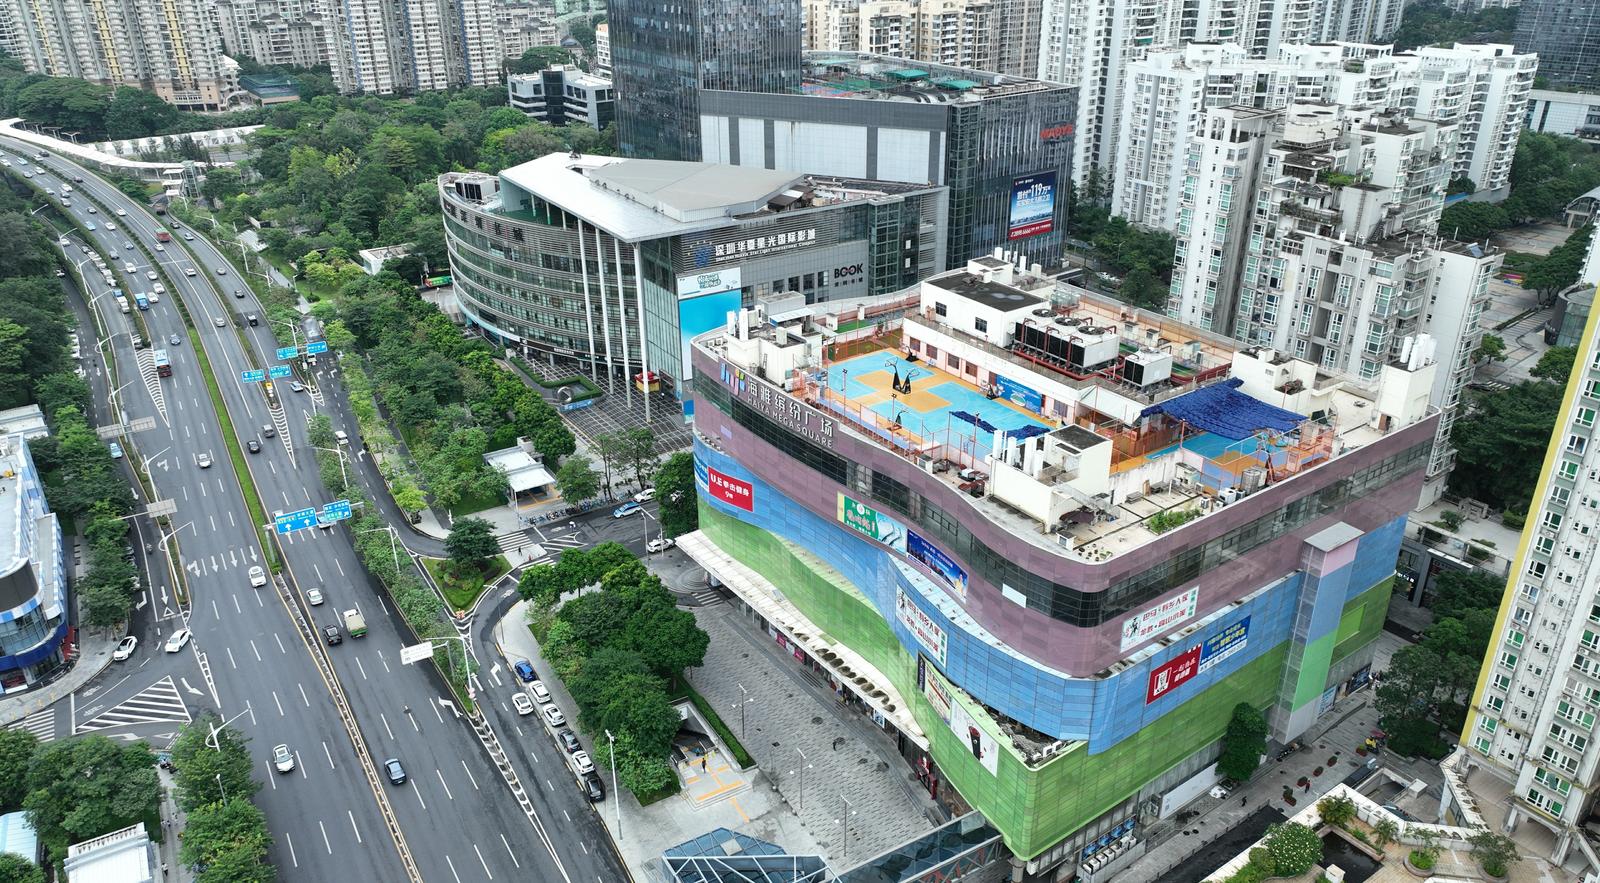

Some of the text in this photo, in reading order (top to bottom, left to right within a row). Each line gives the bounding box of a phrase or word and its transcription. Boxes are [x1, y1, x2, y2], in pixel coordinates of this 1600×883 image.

[834, 263, 863, 278] BOOK
[748, 379, 833, 437] 海雅缤纷广场
[772, 410, 794, 428] MEGA
[796, 423, 832, 448] SQUARE
